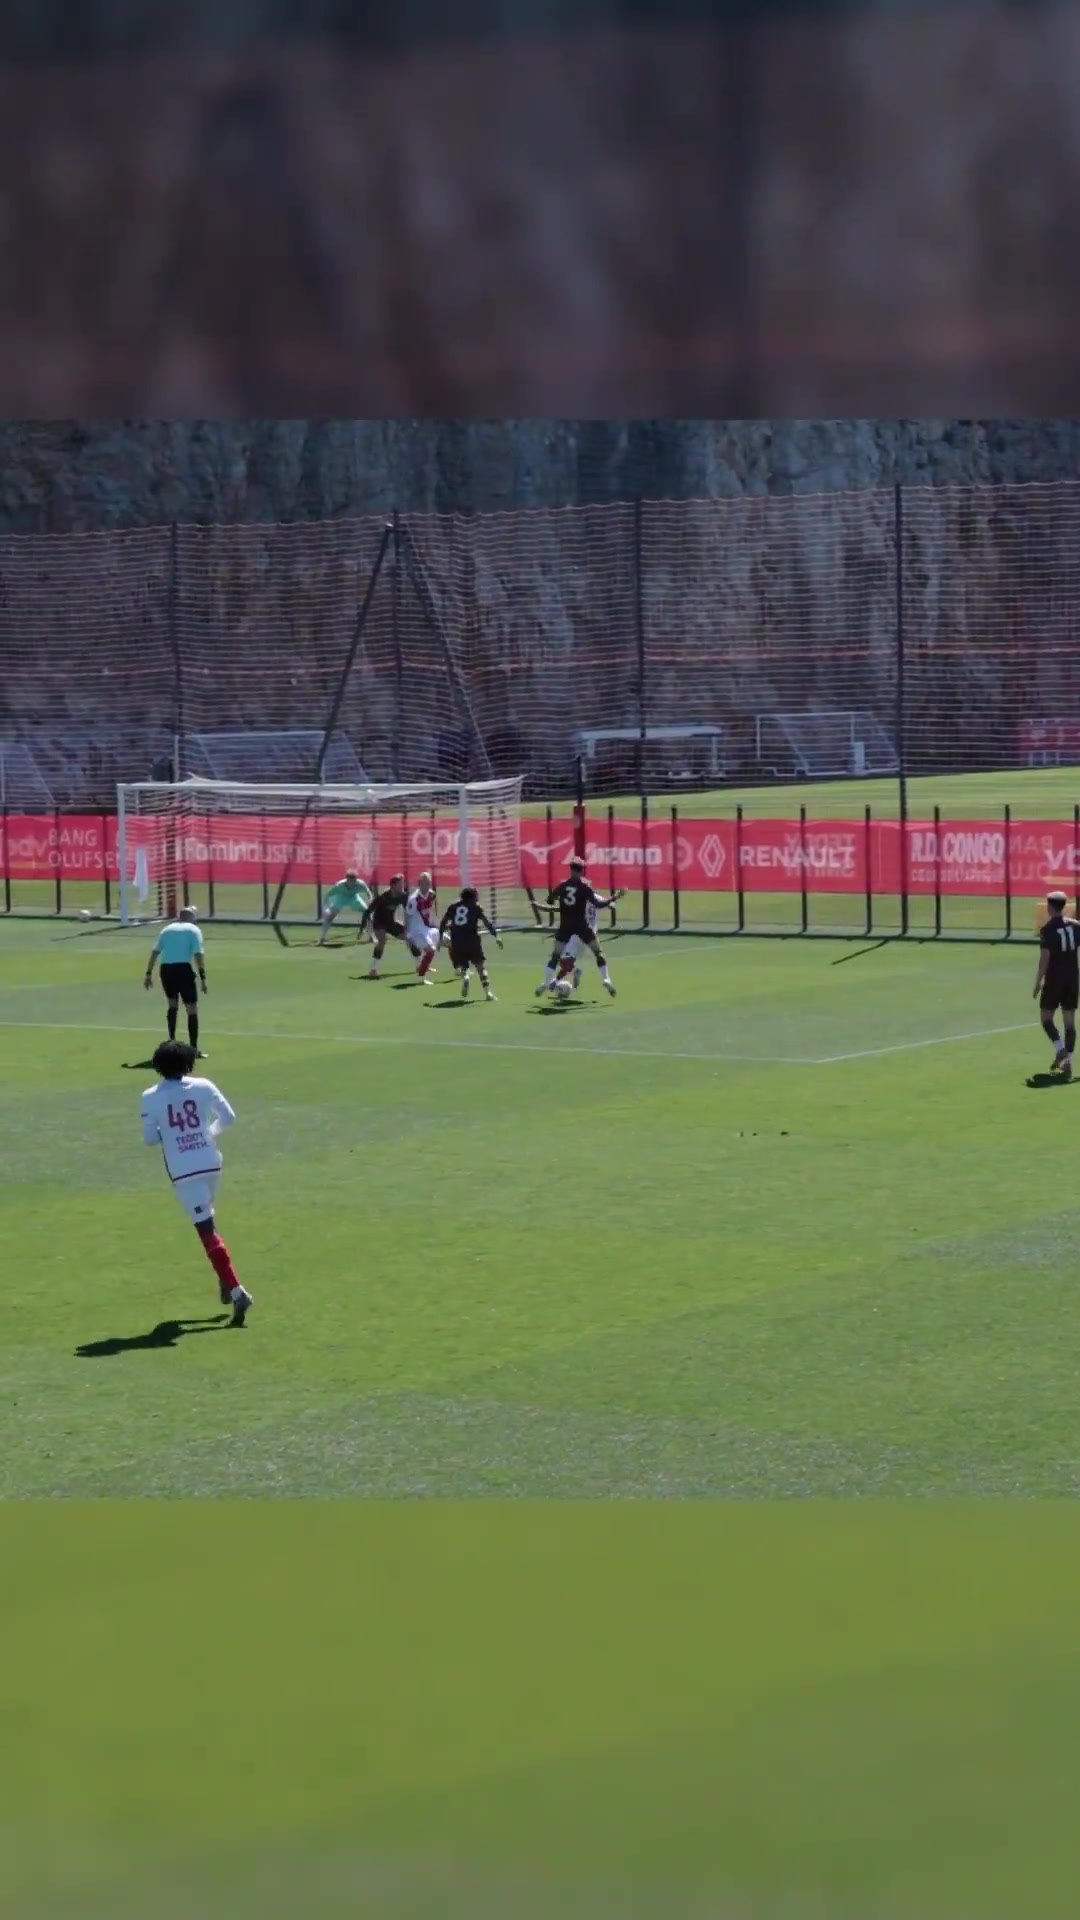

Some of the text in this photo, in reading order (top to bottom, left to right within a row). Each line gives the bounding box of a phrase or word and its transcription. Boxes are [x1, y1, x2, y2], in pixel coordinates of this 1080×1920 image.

[49, 828, 98, 847] BANG
[411, 828, 480, 865] apm
[942, 831, 1005, 864] CONGO
[49, 850, 120, 868] OLUFSE
[740, 845, 856, 868] RENAULT
[563, 887, 577, 906] 3
[454, 905, 469, 926] 8
[1056, 925, 1076, 952] 11
[167, 1099, 200, 1132] 48
